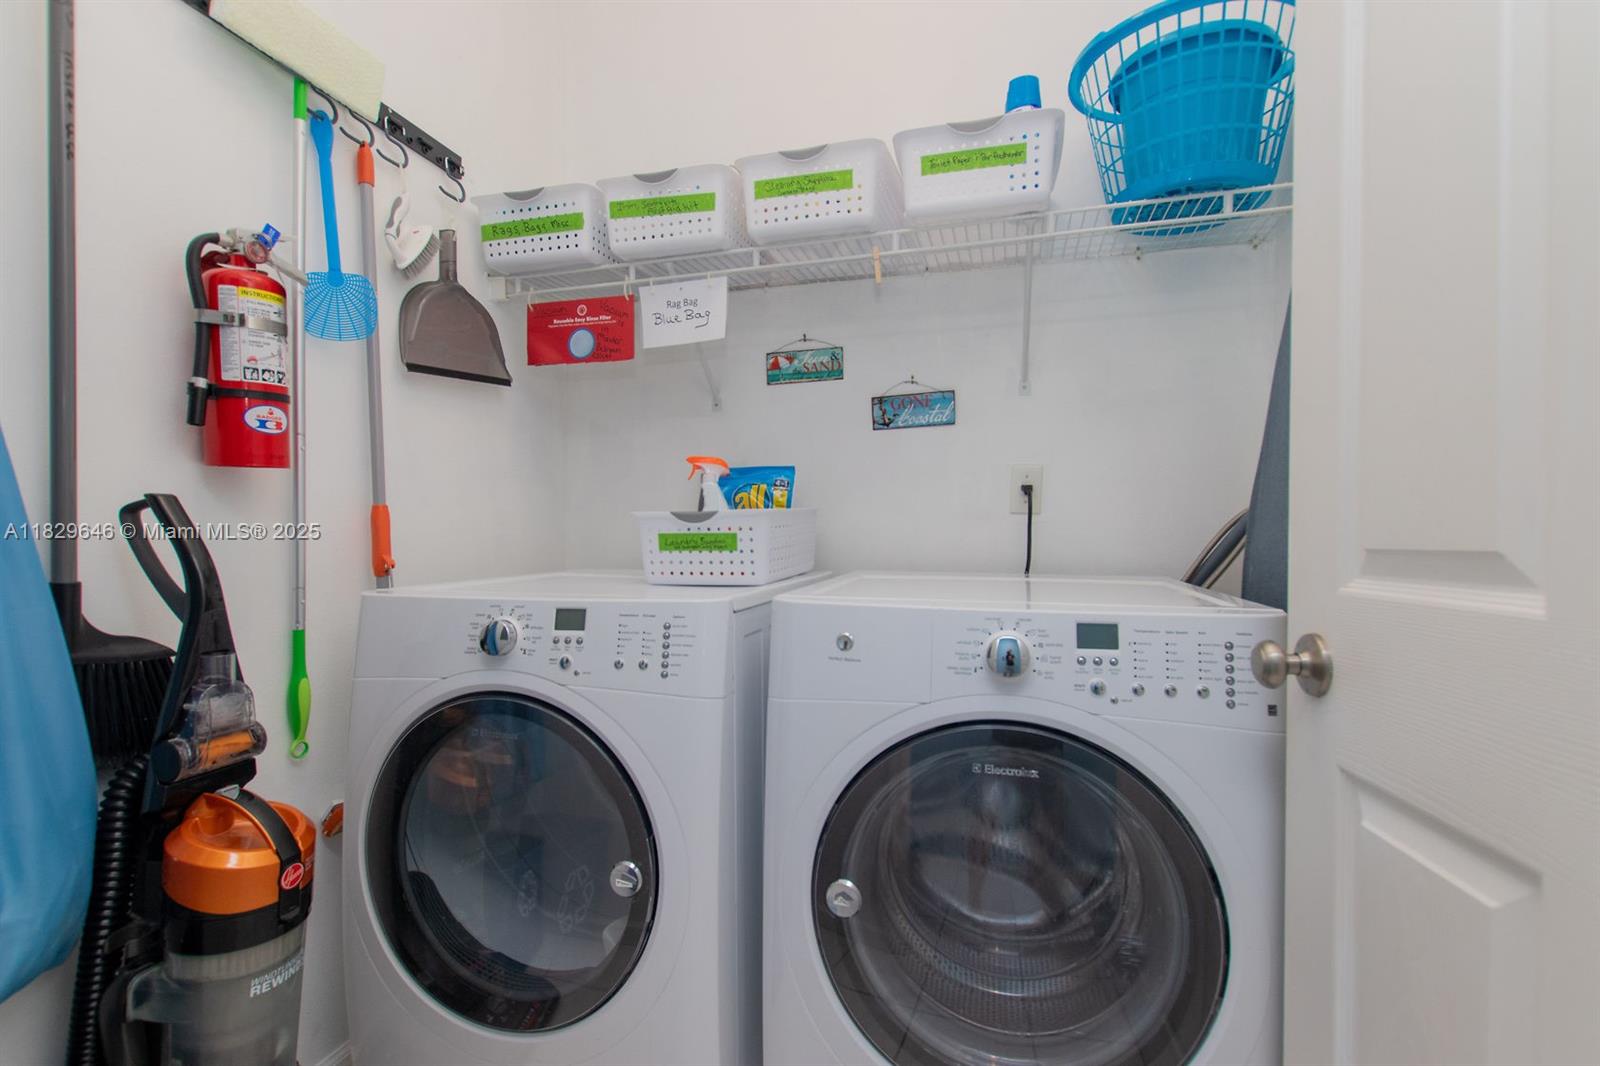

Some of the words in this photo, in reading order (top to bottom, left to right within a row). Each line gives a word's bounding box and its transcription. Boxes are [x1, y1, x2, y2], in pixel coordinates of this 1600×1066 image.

[665, 299, 681, 310] Rag
[682, 298, 699, 309] Bag
[652, 312, 682, 327] Blue
[685, 308, 711, 329] Bag
[802, 360, 842, 373] SAND
[735, 483, 768, 509] all
[984, 763, 1040, 779] Electrolux
